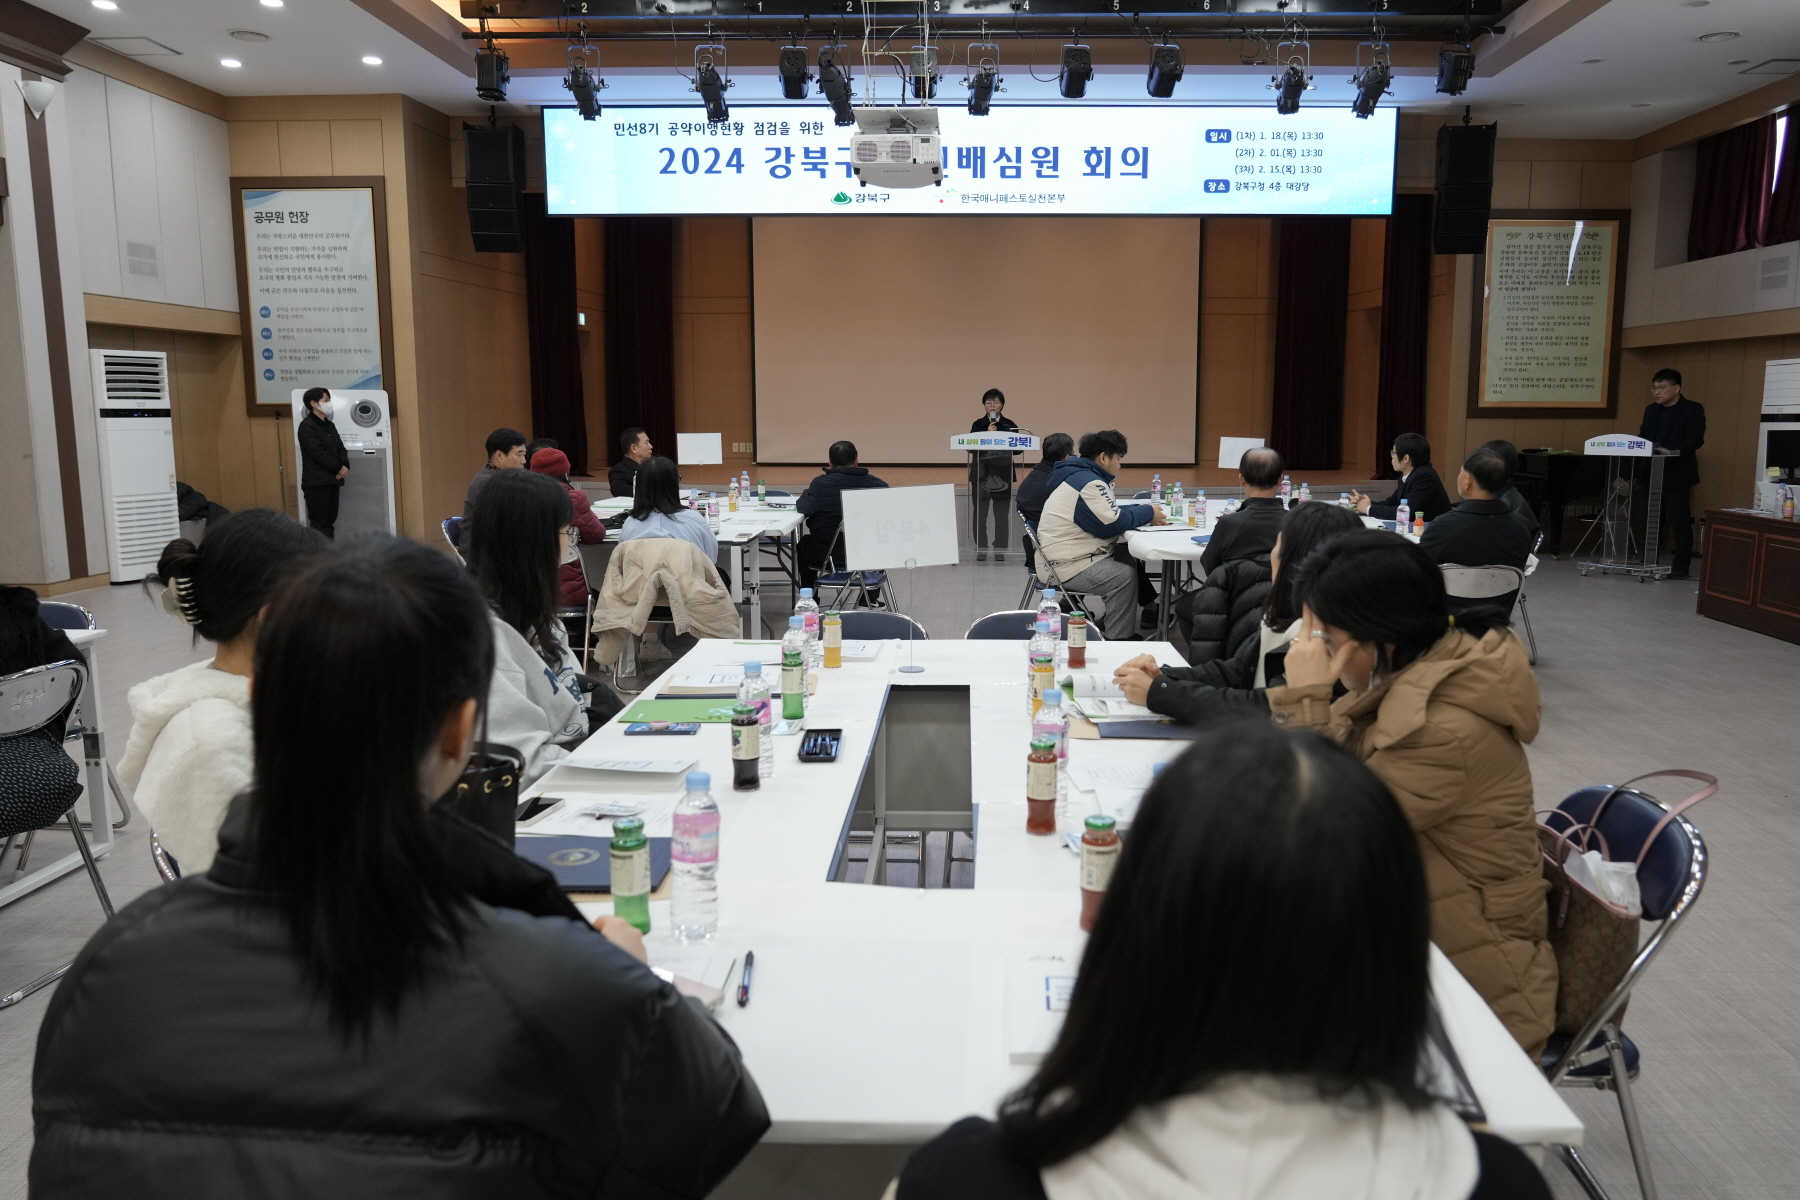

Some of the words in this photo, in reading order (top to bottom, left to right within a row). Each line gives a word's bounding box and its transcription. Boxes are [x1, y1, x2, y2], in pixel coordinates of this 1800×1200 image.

[496, 4, 501, 14] 1
[581, 3, 588, 13] 2
[668, 3, 675, 13] 3
[758, 2, 762, 12] 1
[846, 1, 853, 12] 2
[934, 1, 940, 11] 3
[1023, 0, 1030, 10] 4
[1113, 0, 1119, 10] 5
[1204, 0, 1210, 10] 6
[1291, 0, 1298, 9] 4
[614, 122, 659, 136] 민선8기
[668, 122, 745, 136] 공약이행현황
[753, 122, 790, 136] 점검을
[799, 122, 824, 135] 위한
[1210, 131, 1227, 141] 일시
[1236, 132, 1256, 141] (1차)
[1271, 132, 1297, 141] 18.(목)
[1235, 149, 1254, 158] (2차)
[1259, 149, 1266, 157] 2.
[1270, 149, 1297, 158] 01.(목)
[658, 147, 745, 174] 2024
[942, 146, 1059, 179] 배심원
[1083, 146, 1148, 179] 회의
[1235, 165, 1254, 174] (3차)
[1270, 165, 1296, 174] 15.(목)
[1208, 182, 1226, 192] 장소
[1234, 182, 1265, 191] 강북구청
[1269, 182, 1281, 191] 4층
[1286, 182, 1309, 191] 대강당
[855, 193, 890, 203] 강북구
[960, 193, 1066, 204] 한국매니페스토실천본부
[254, 211, 284, 224] 공무원
[288, 211, 309, 224] 헌장
[1008, 437, 1032, 447] 강북!
[1628, 441, 1646, 449] 강북!
